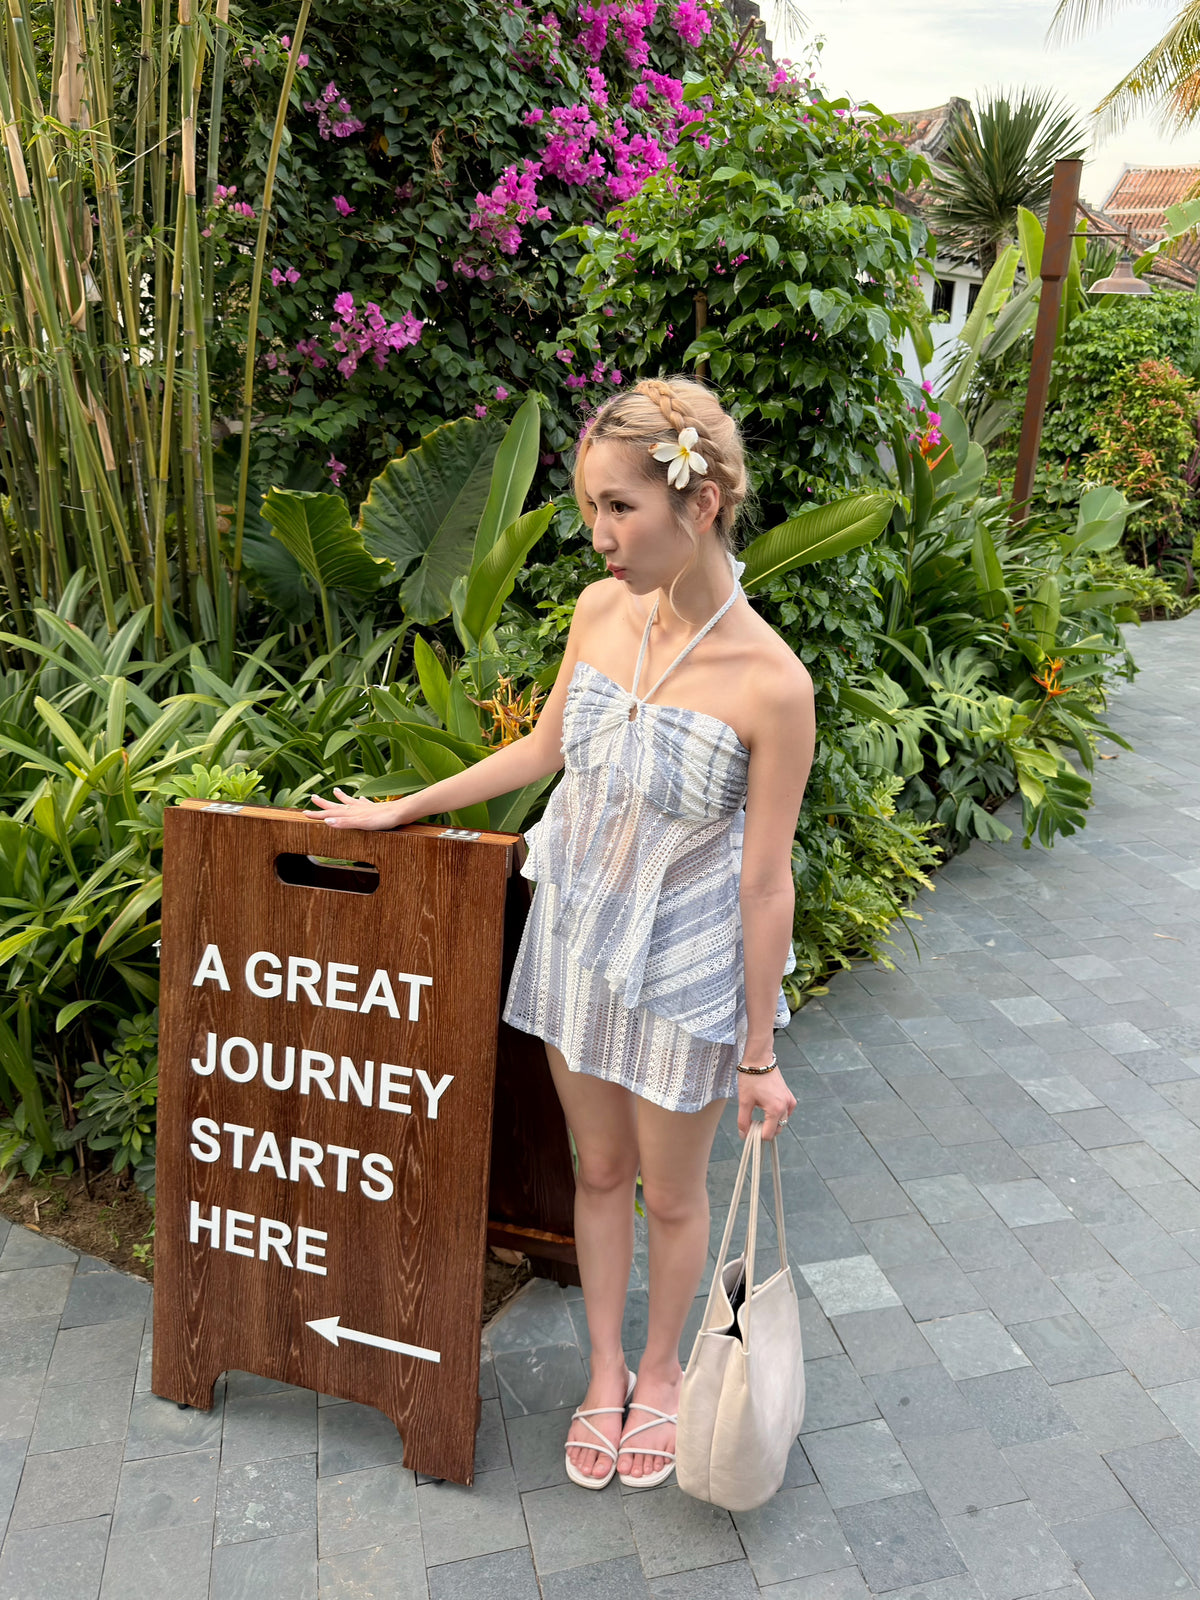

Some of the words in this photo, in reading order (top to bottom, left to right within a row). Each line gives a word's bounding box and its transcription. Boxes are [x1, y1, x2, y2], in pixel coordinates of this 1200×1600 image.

[192, 943, 231, 992] A
[244, 951, 433, 1022] GREAT
[190, 1032, 455, 1120] JOURNEY
[190, 1117, 394, 1201] STARTS
[189, 1200, 328, 1276] HERE
